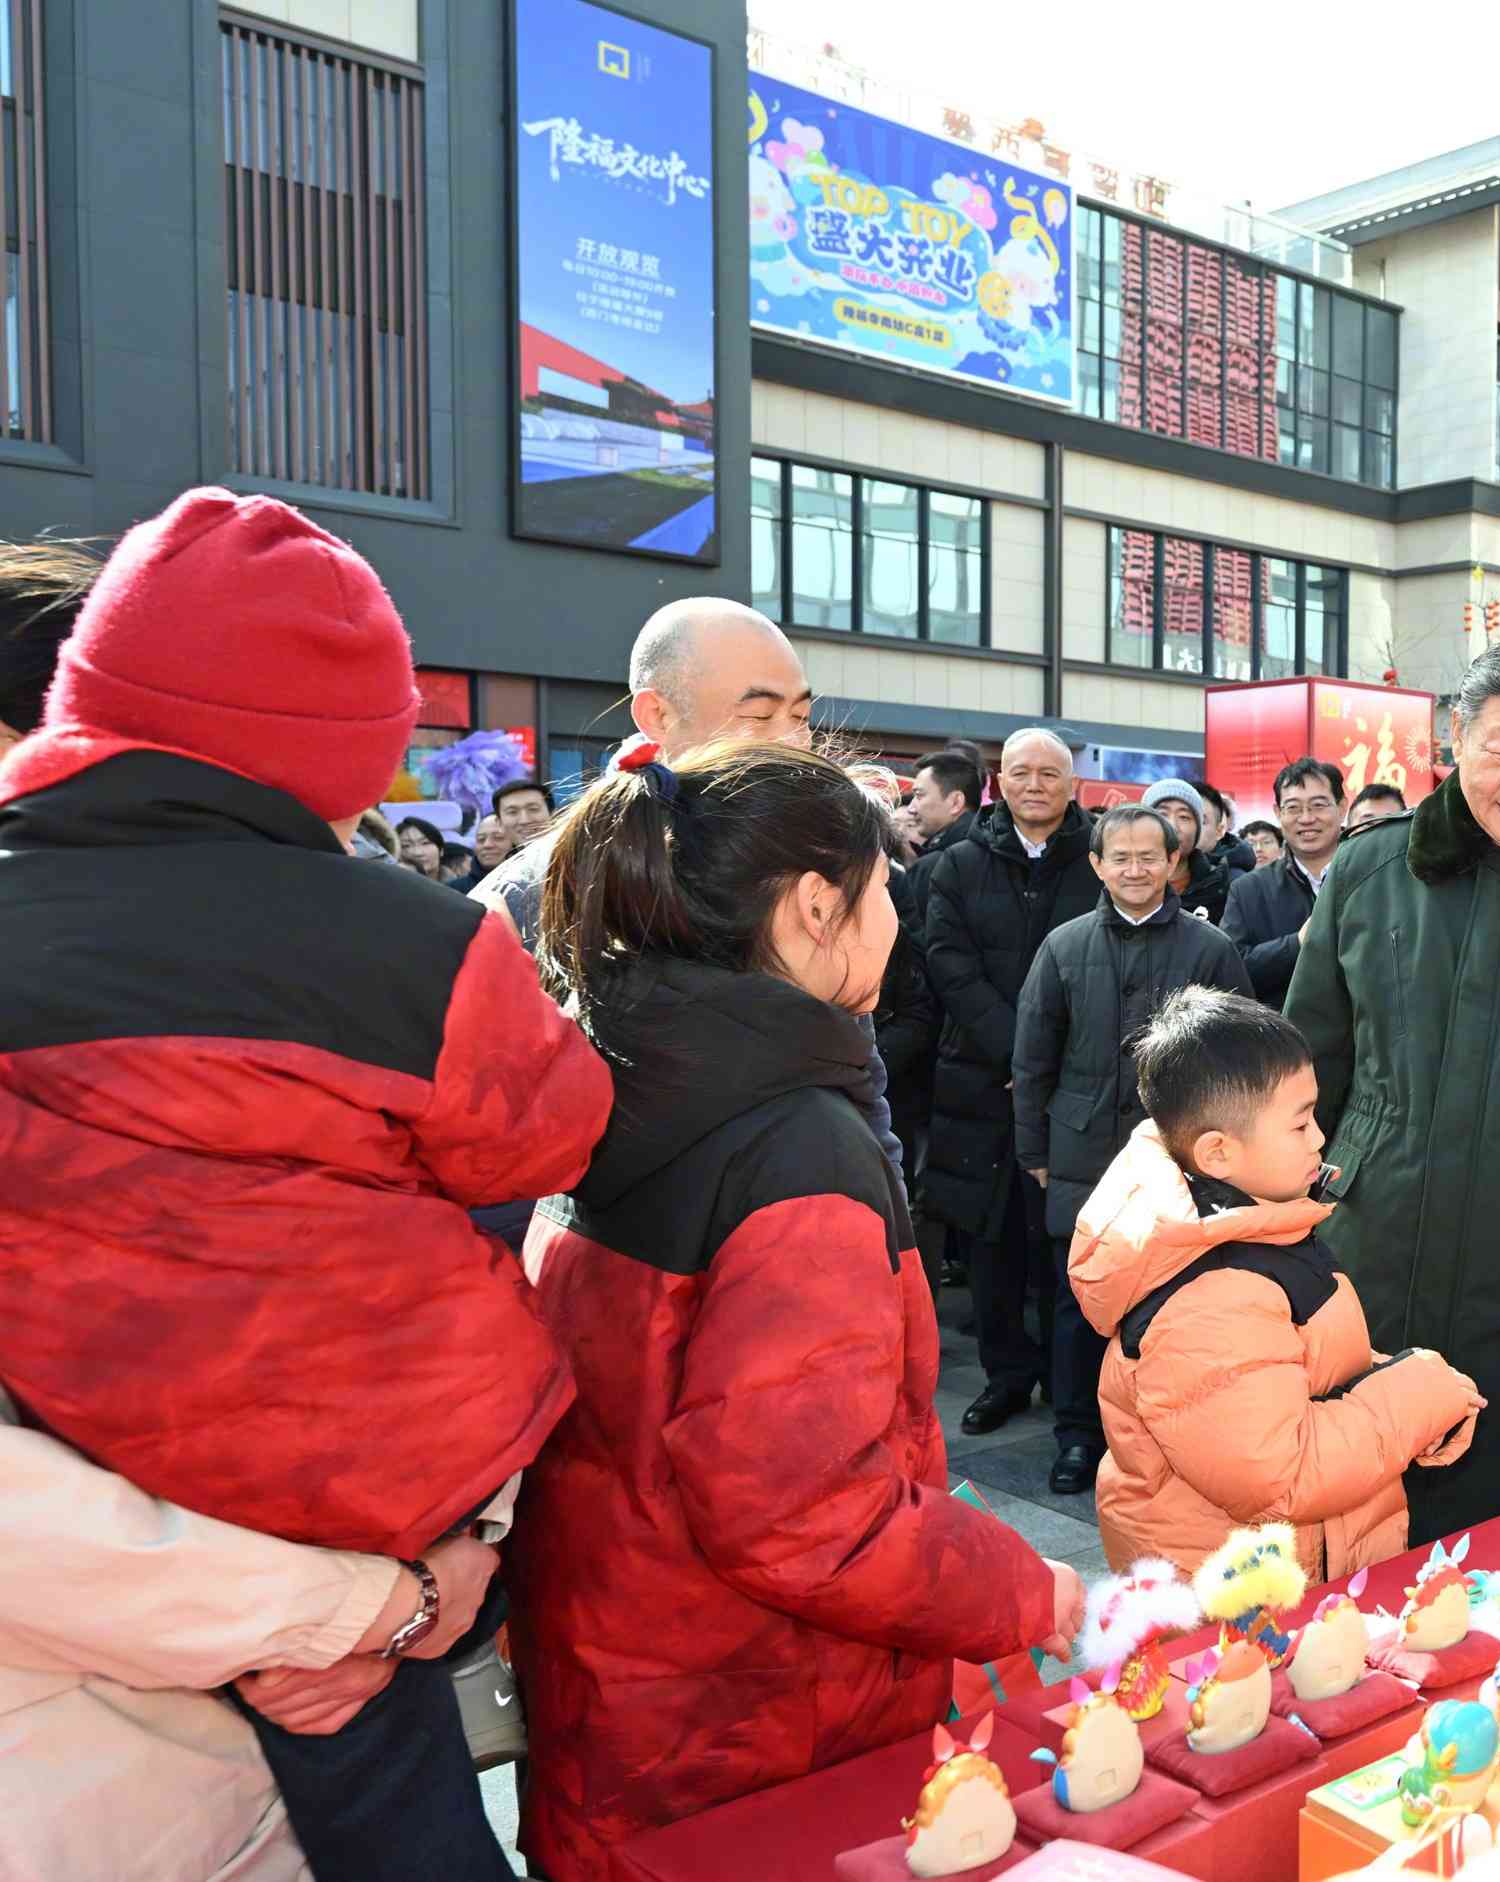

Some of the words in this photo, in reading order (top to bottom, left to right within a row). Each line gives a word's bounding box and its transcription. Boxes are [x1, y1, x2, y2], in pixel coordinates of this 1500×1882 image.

[810, 174, 891, 221] TOP
[900, 201, 973, 249] TOY
[810, 208, 974, 298] 盛大开业
